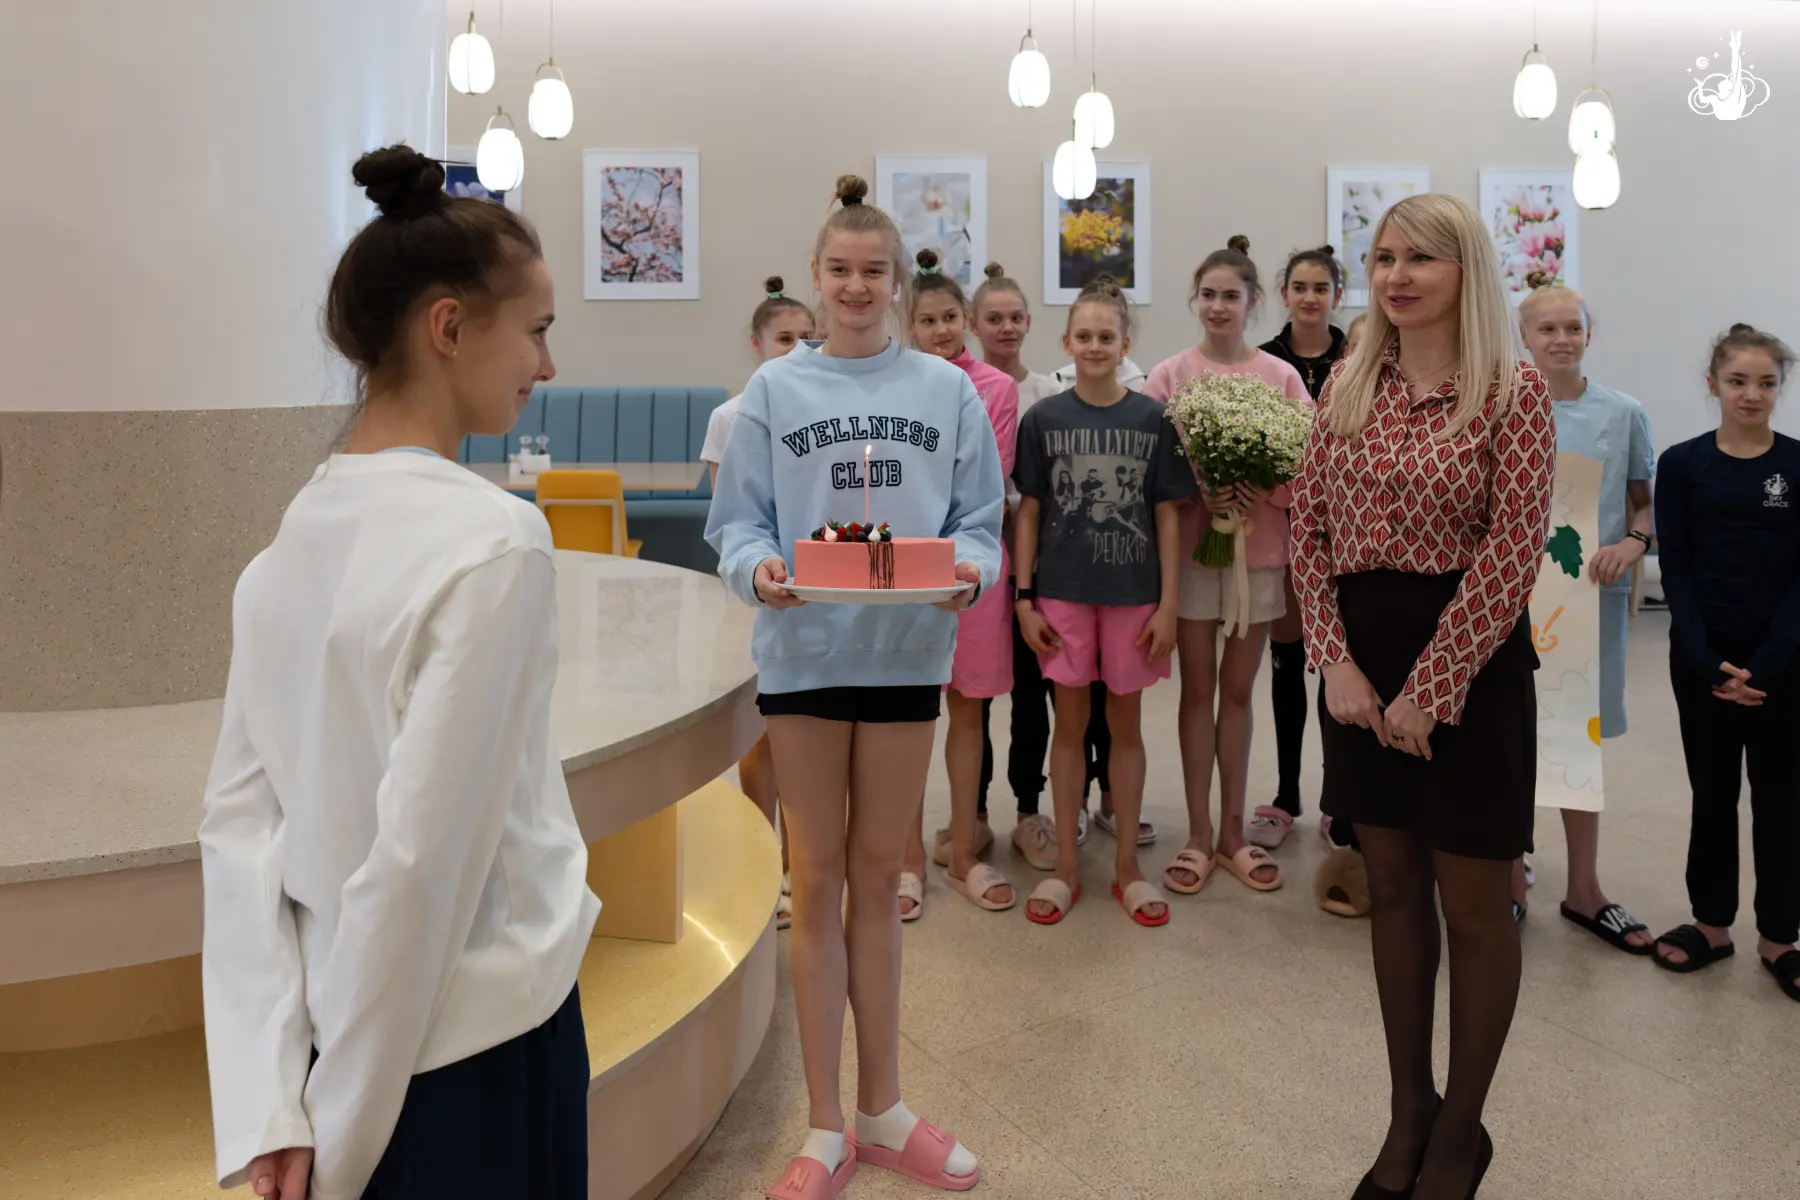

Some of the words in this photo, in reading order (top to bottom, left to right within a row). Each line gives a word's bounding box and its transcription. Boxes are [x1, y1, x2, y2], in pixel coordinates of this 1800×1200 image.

[781, 416, 940, 457] WELLNESS
[1044, 428, 1100, 457] UDACHA
[831, 459, 902, 489] CLUB
